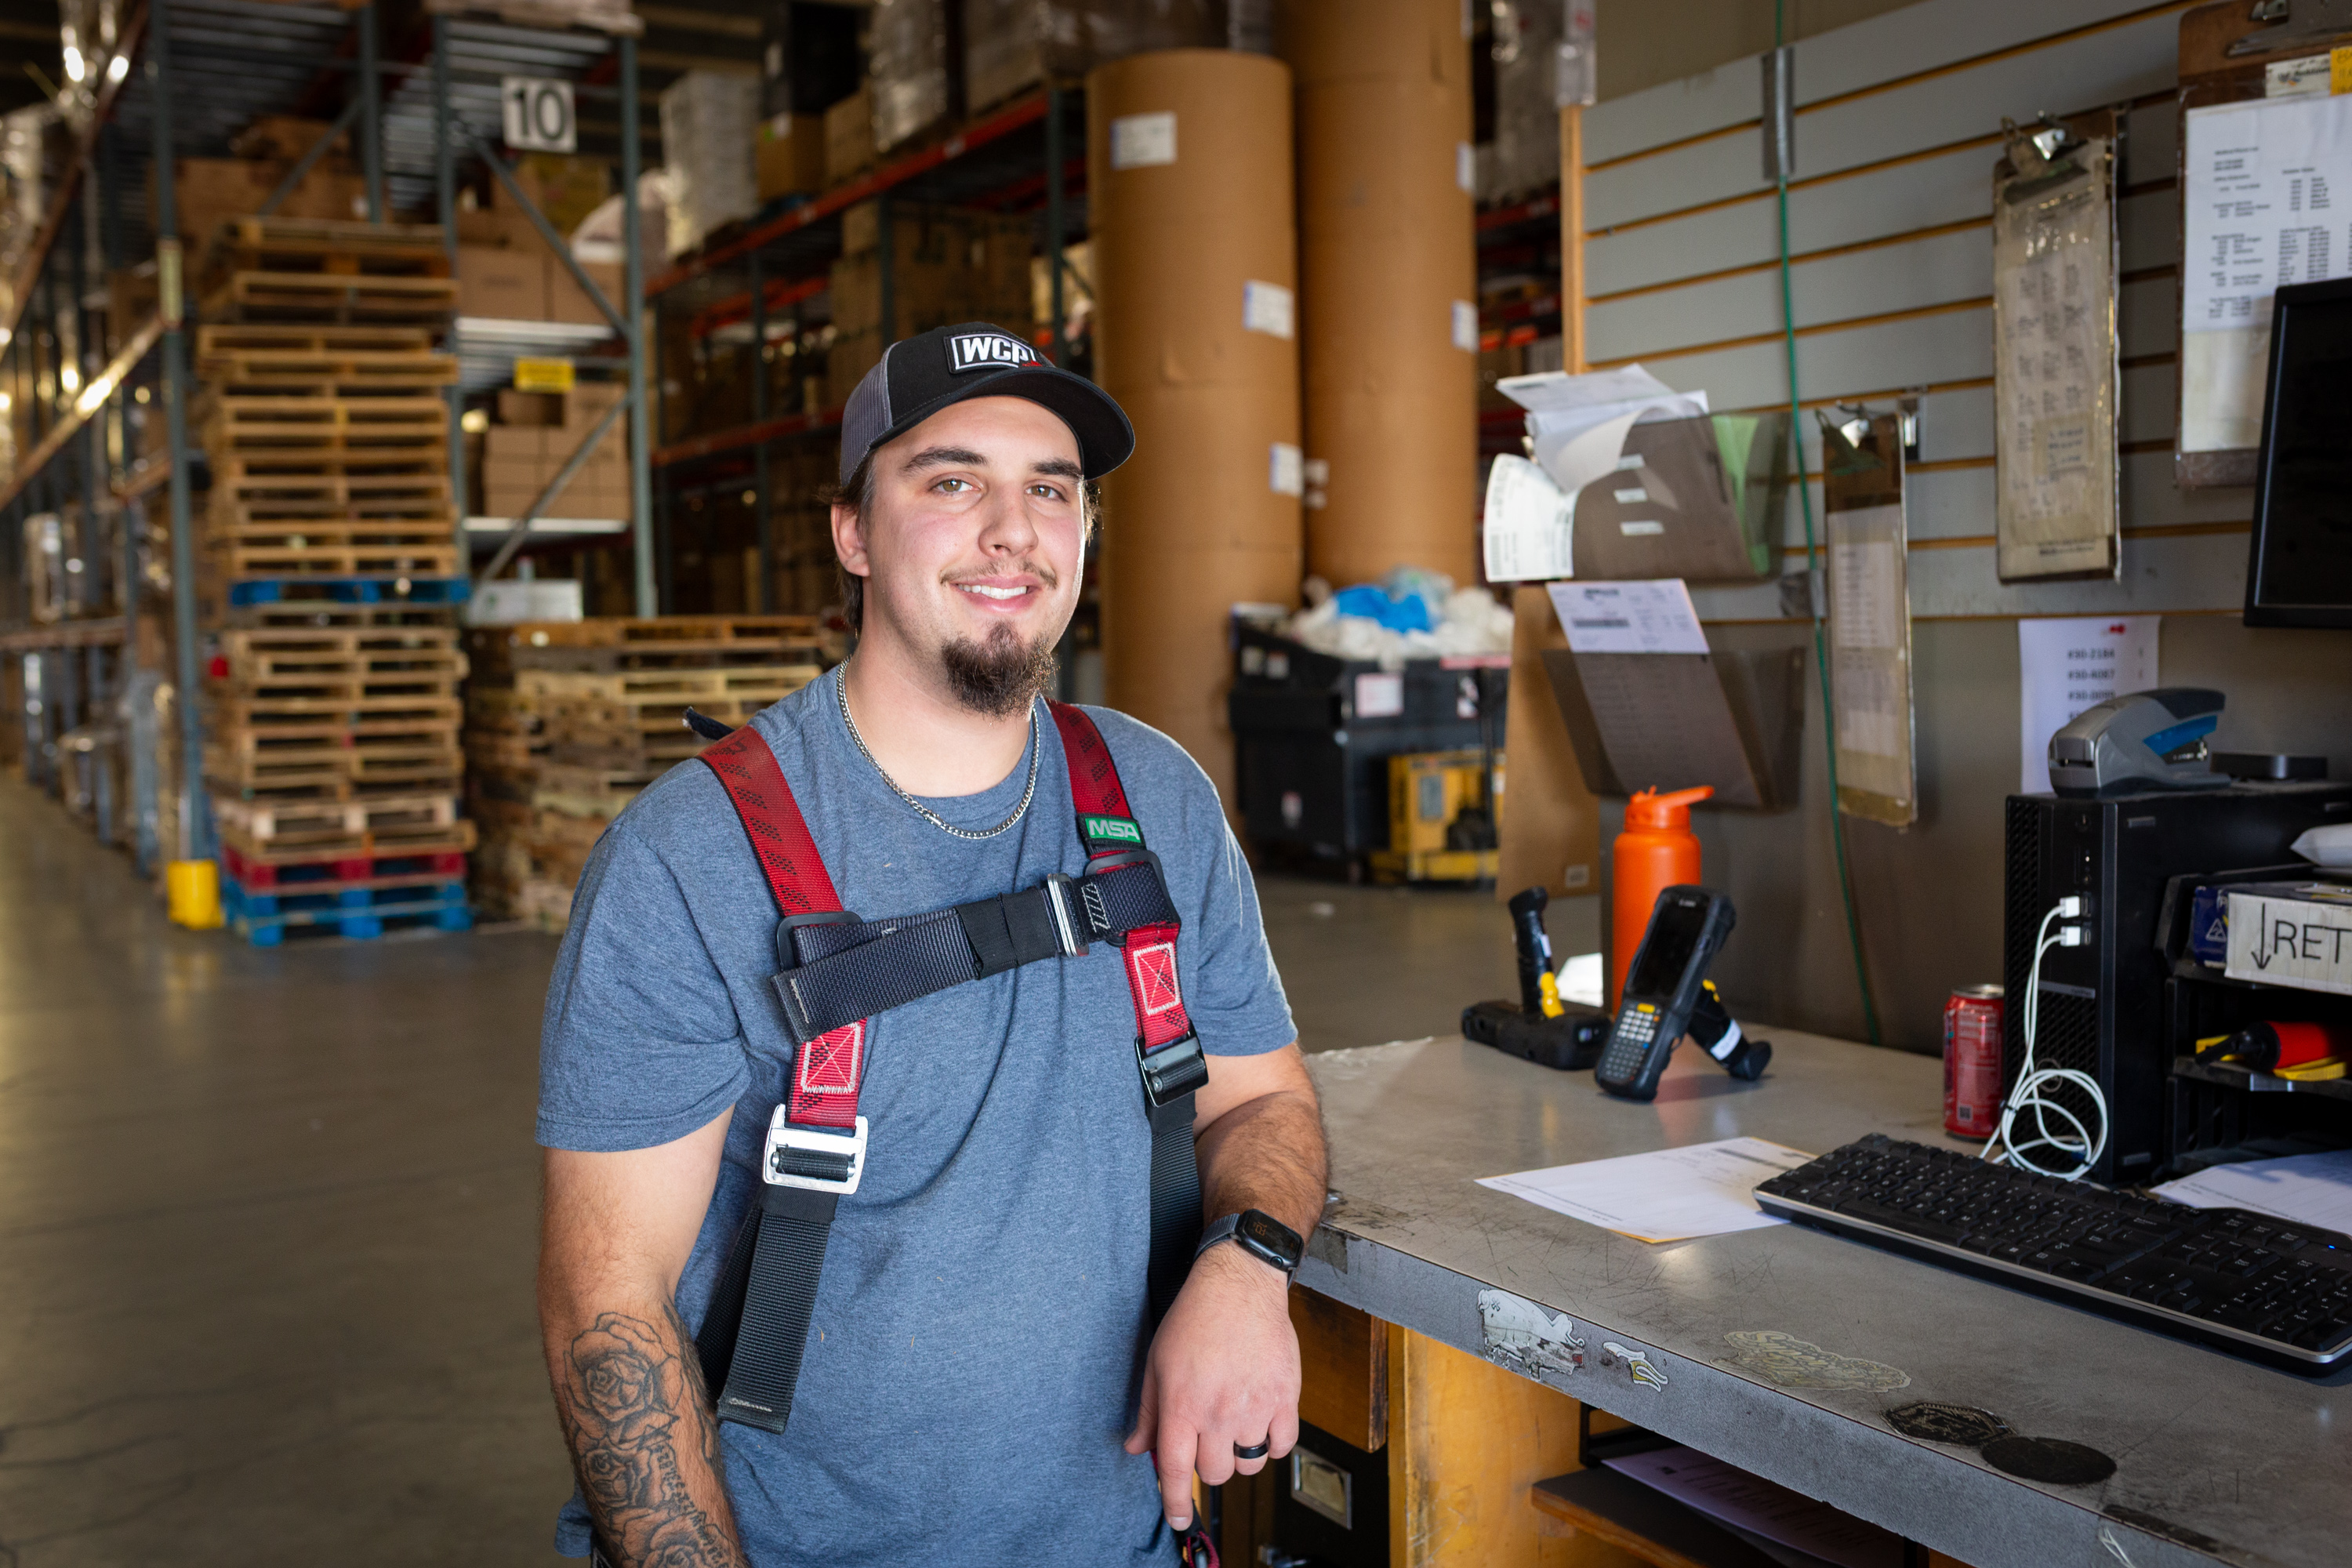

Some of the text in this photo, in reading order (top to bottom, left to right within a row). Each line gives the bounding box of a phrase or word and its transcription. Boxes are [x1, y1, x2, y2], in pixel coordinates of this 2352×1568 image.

[513, 88, 566, 142] 10
[962, 336, 1029, 364] WCP
[1088, 819, 1141, 840] MSA
